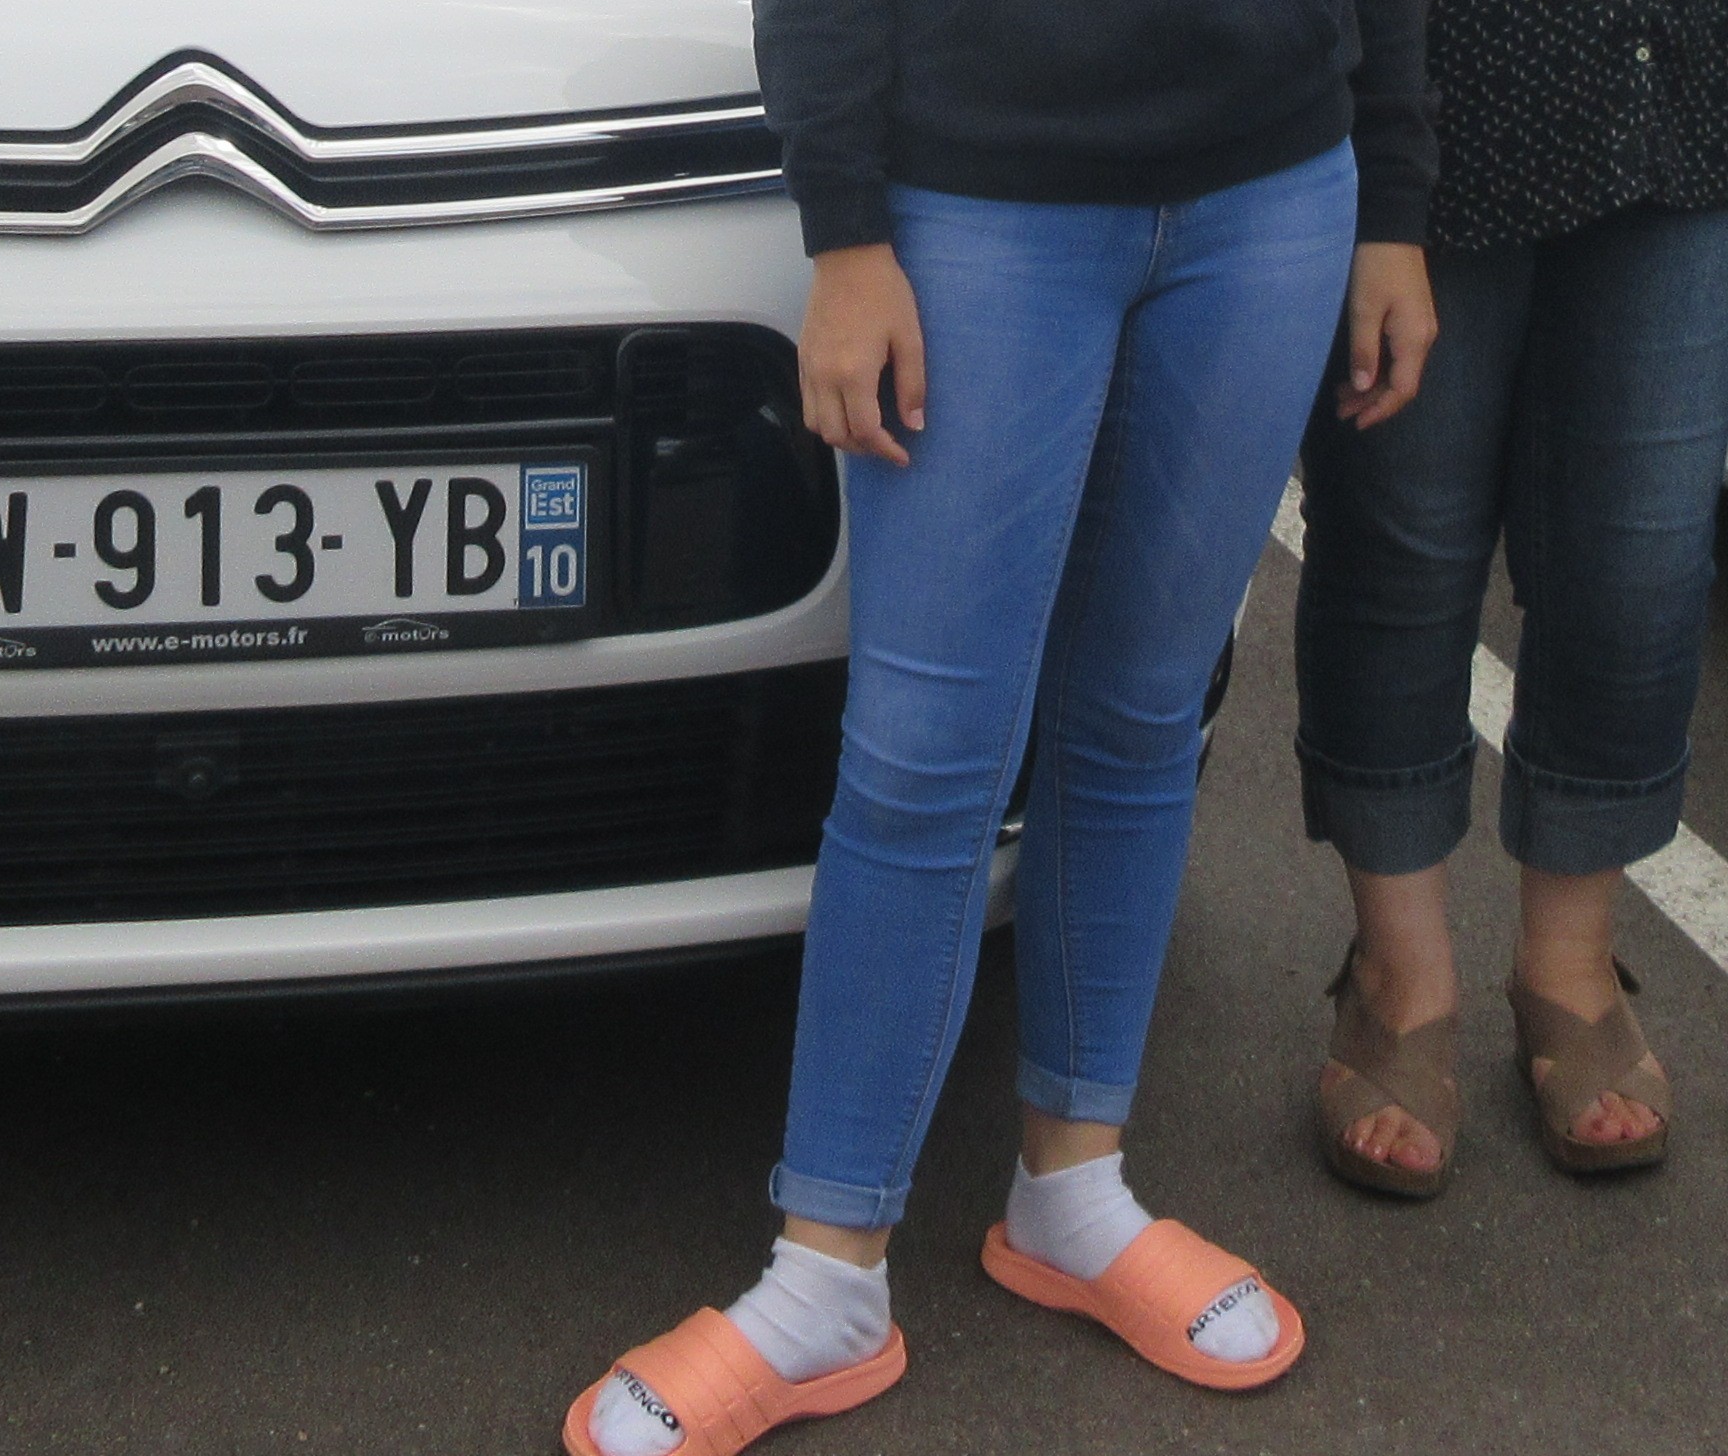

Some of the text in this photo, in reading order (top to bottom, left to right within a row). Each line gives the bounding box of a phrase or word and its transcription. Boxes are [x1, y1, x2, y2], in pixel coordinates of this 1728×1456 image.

[530, 477, 576, 492] Grand
[530, 492, 575, 517] Est
[525, 544, 578, 597] 10
[91, 626, 309, 653] www.e-motors.fr
[616, 1368, 680, 1432] RTENGO
